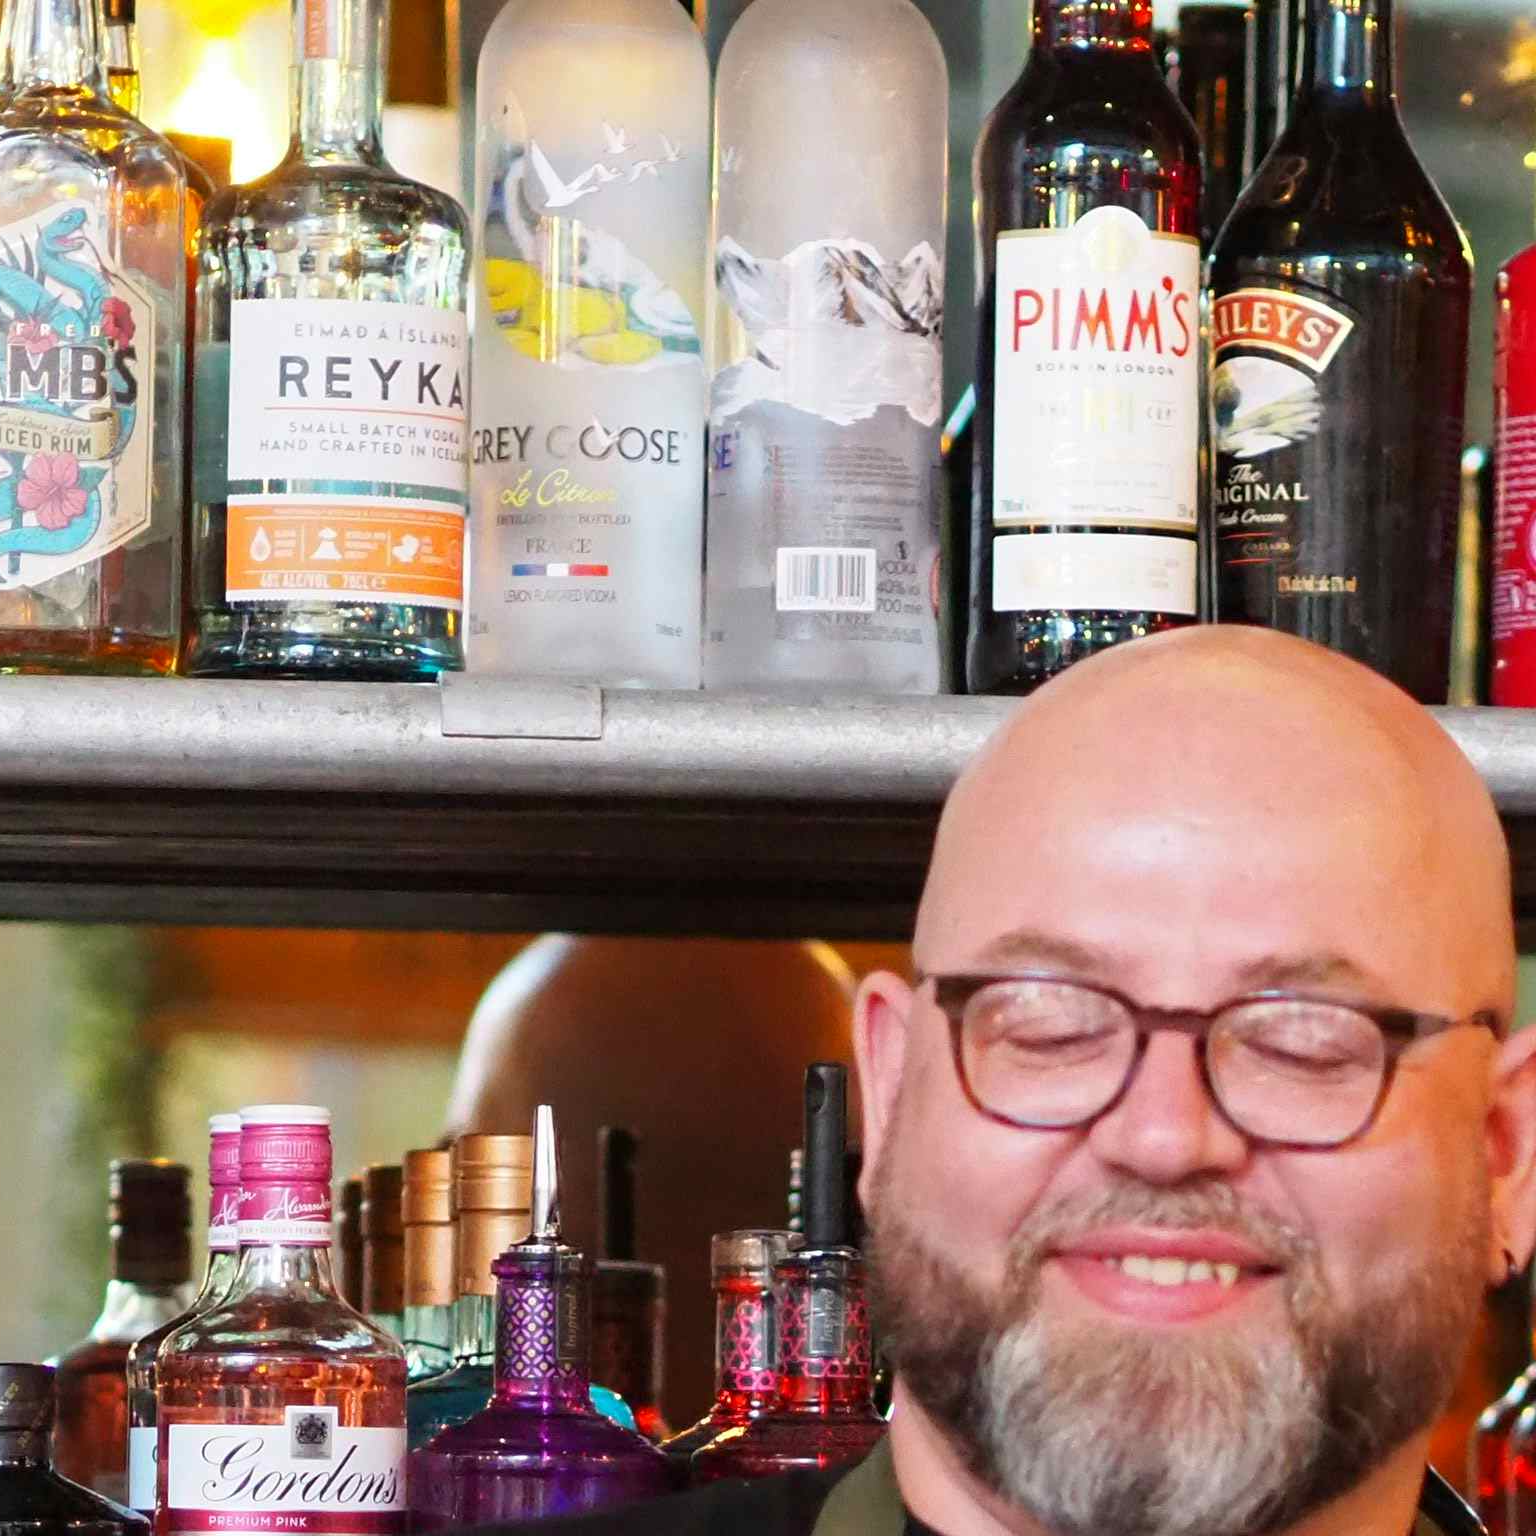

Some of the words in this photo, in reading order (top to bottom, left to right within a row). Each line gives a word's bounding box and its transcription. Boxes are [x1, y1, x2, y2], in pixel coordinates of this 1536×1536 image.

[1013, 275, 1190, 357] PIMM'S
[1219, 302, 1334, 348] ILEYS
[1115, 364, 1175, 377] LONDON
[278, 355, 465, 411] REYKA
[288, 420, 349, 435] SMALL
[359, 422, 417, 438] BATCH
[50, 433, 92, 456] RUM
[259, 439, 308, 452] HAND
[319, 440, 402, 456] CRAFTED
[410, 445, 425, 457] IN
[472, 426, 533, 464] GREY
[1216, 481, 1310, 505] RIGINAL
[201, 1435, 400, 1506] Gordon's
[208, 1515, 271, 1528] PREMIUM
[275, 1516, 308, 1528] PINK
